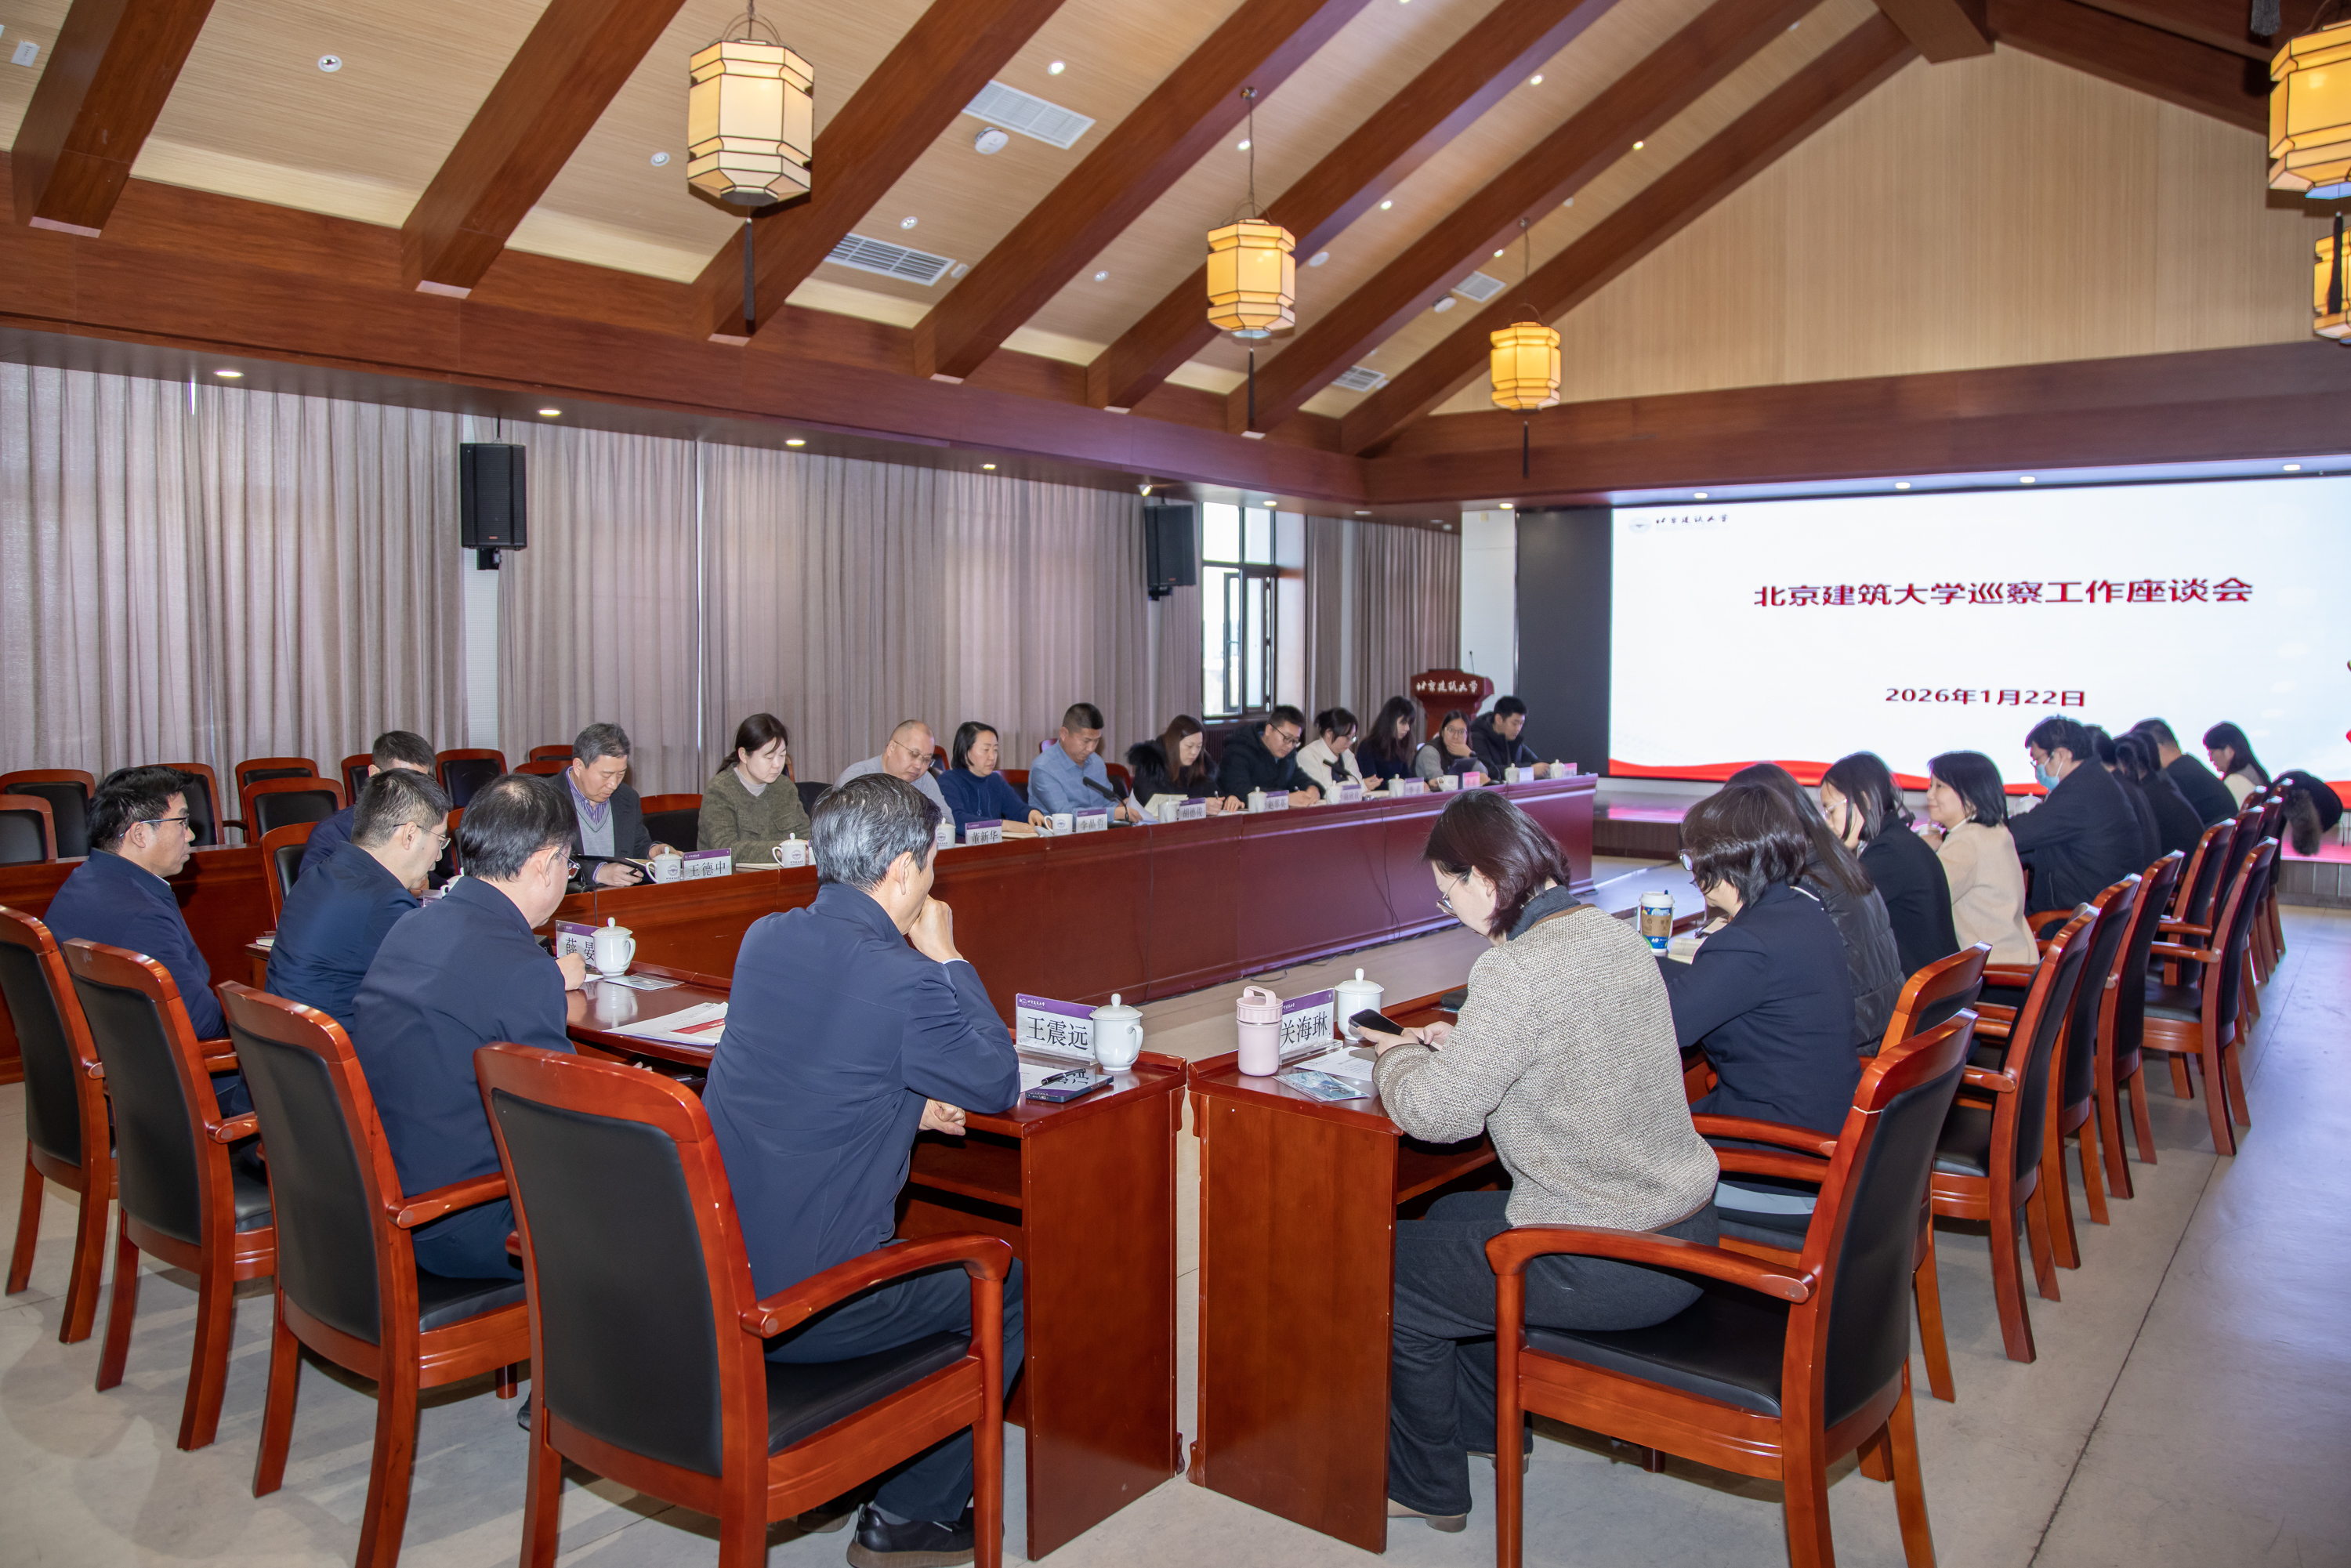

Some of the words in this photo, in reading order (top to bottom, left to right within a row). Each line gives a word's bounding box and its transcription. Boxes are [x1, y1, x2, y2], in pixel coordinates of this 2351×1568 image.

[1754, 577, 2253, 607] 北京建筑大学巡察工作座谈会
[1886, 688, 2085, 707] 2026年1月22日
[1080, 817, 1104, 831] 李晶哲
[971, 829, 998, 845] 董新华
[689, 860, 726, 878] 王德中
[1026, 1016, 1089, 1051] 王震远
[1281, 1011, 1328, 1048] 关海琳
